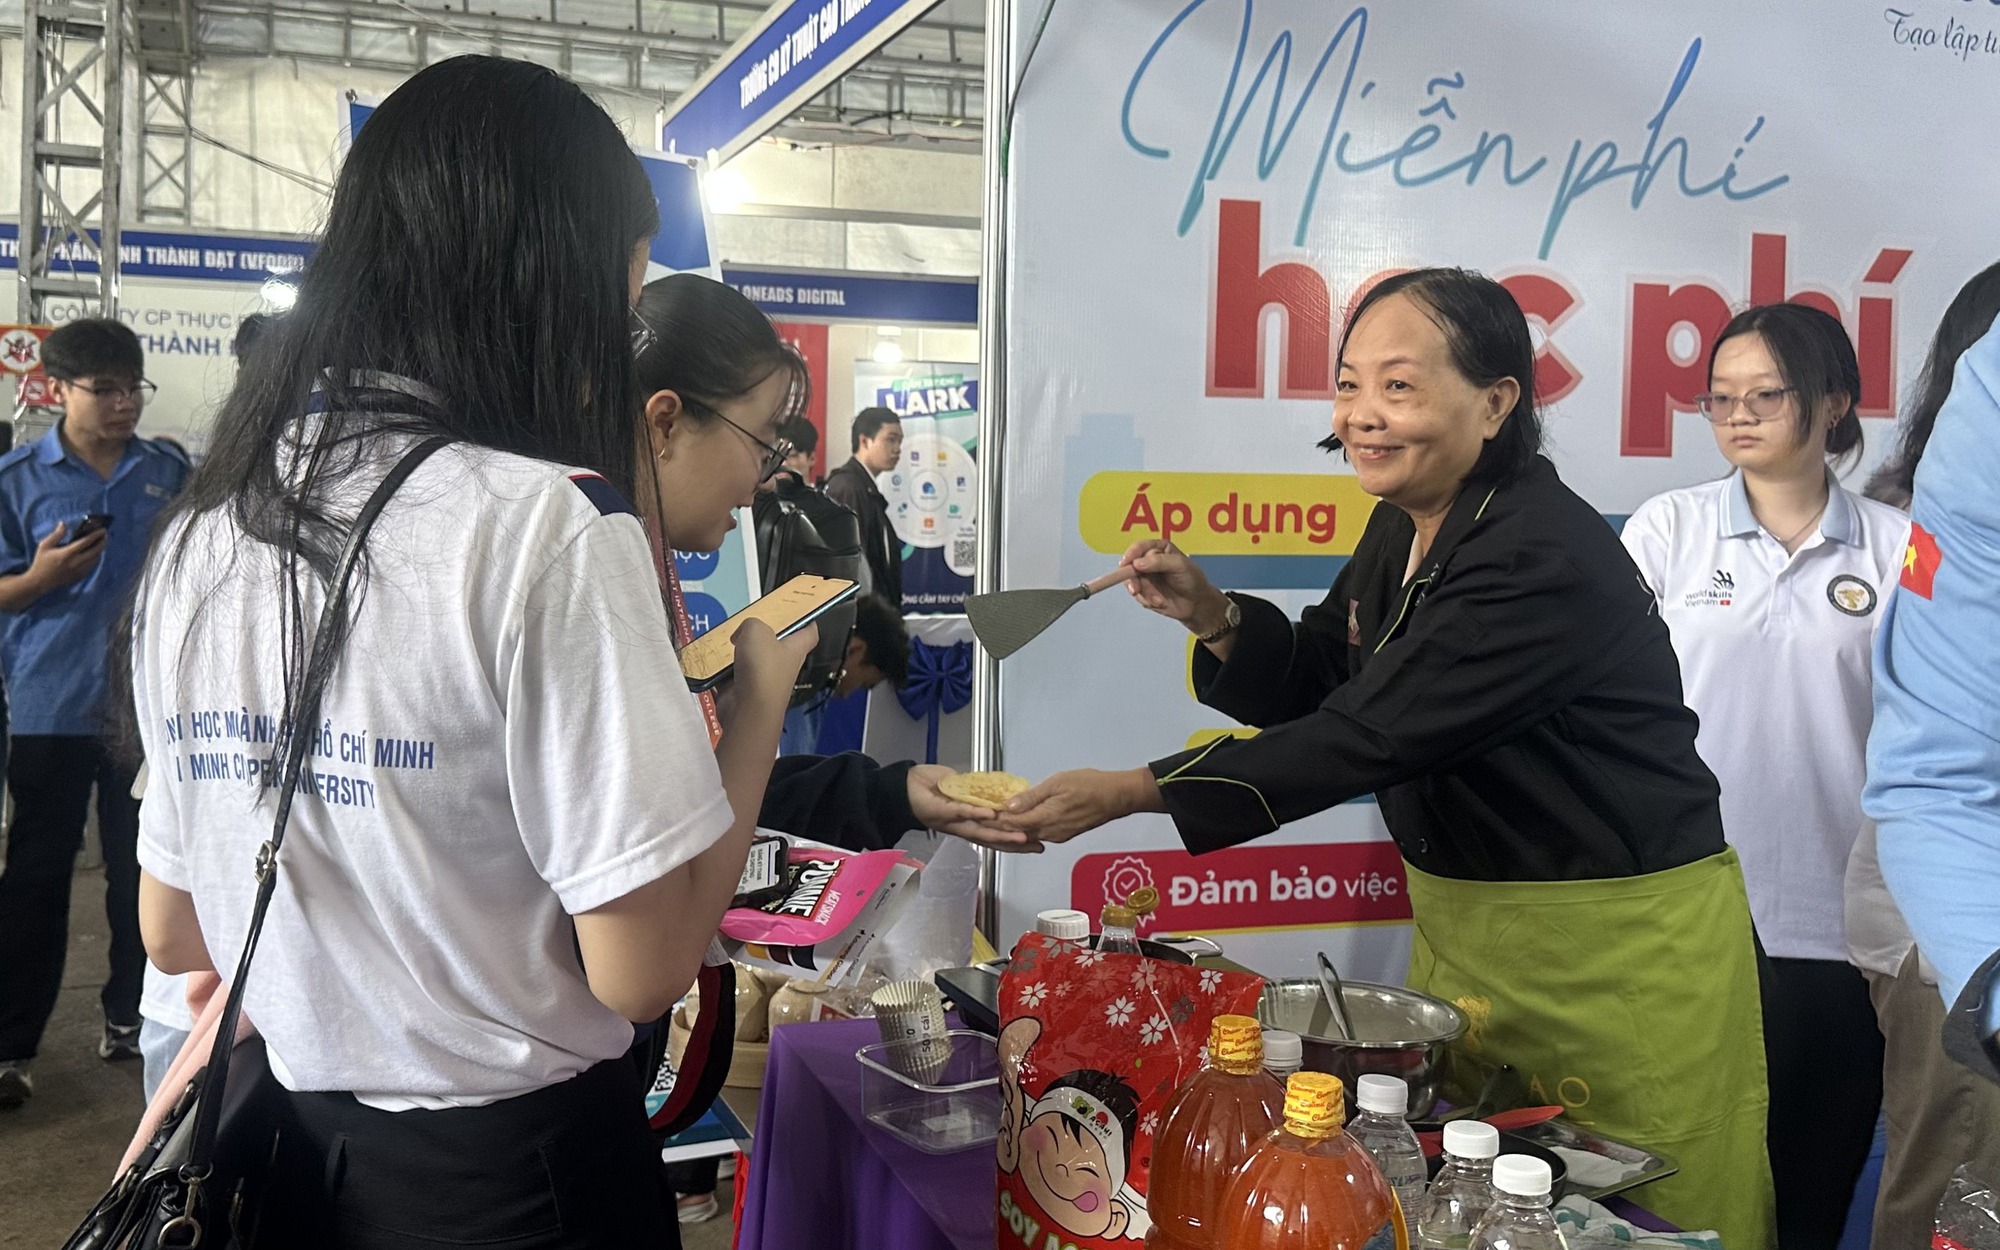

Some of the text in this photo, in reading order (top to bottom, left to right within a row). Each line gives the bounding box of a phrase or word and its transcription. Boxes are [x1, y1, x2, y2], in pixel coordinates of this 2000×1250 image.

[1884, 8, 1938, 51] Tạo
[1944, 16, 1985, 61] lập
[1537, 37, 1790, 260] phí
[146, 244, 200, 267] THÀNH
[204, 250, 237, 272] ĐẠT
[742, 285, 794, 304] ONEADS
[797, 288, 846, 306] DIGITAL
[145, 310, 172, 326] CP
[176, 312, 231, 331] THỰC
[885, 384, 972, 417] LARK
[1121, 482, 1336, 544] Áp dụng
[192, 711, 221, 743] HỌC
[340, 729, 367, 765] CHÍ
[373, 738, 435, 770] MINH
[189, 753, 231, 781] MINH
[1168, 865, 1398, 907] Đảm bảo việc
[1000, 1190, 1041, 1249] SOY
